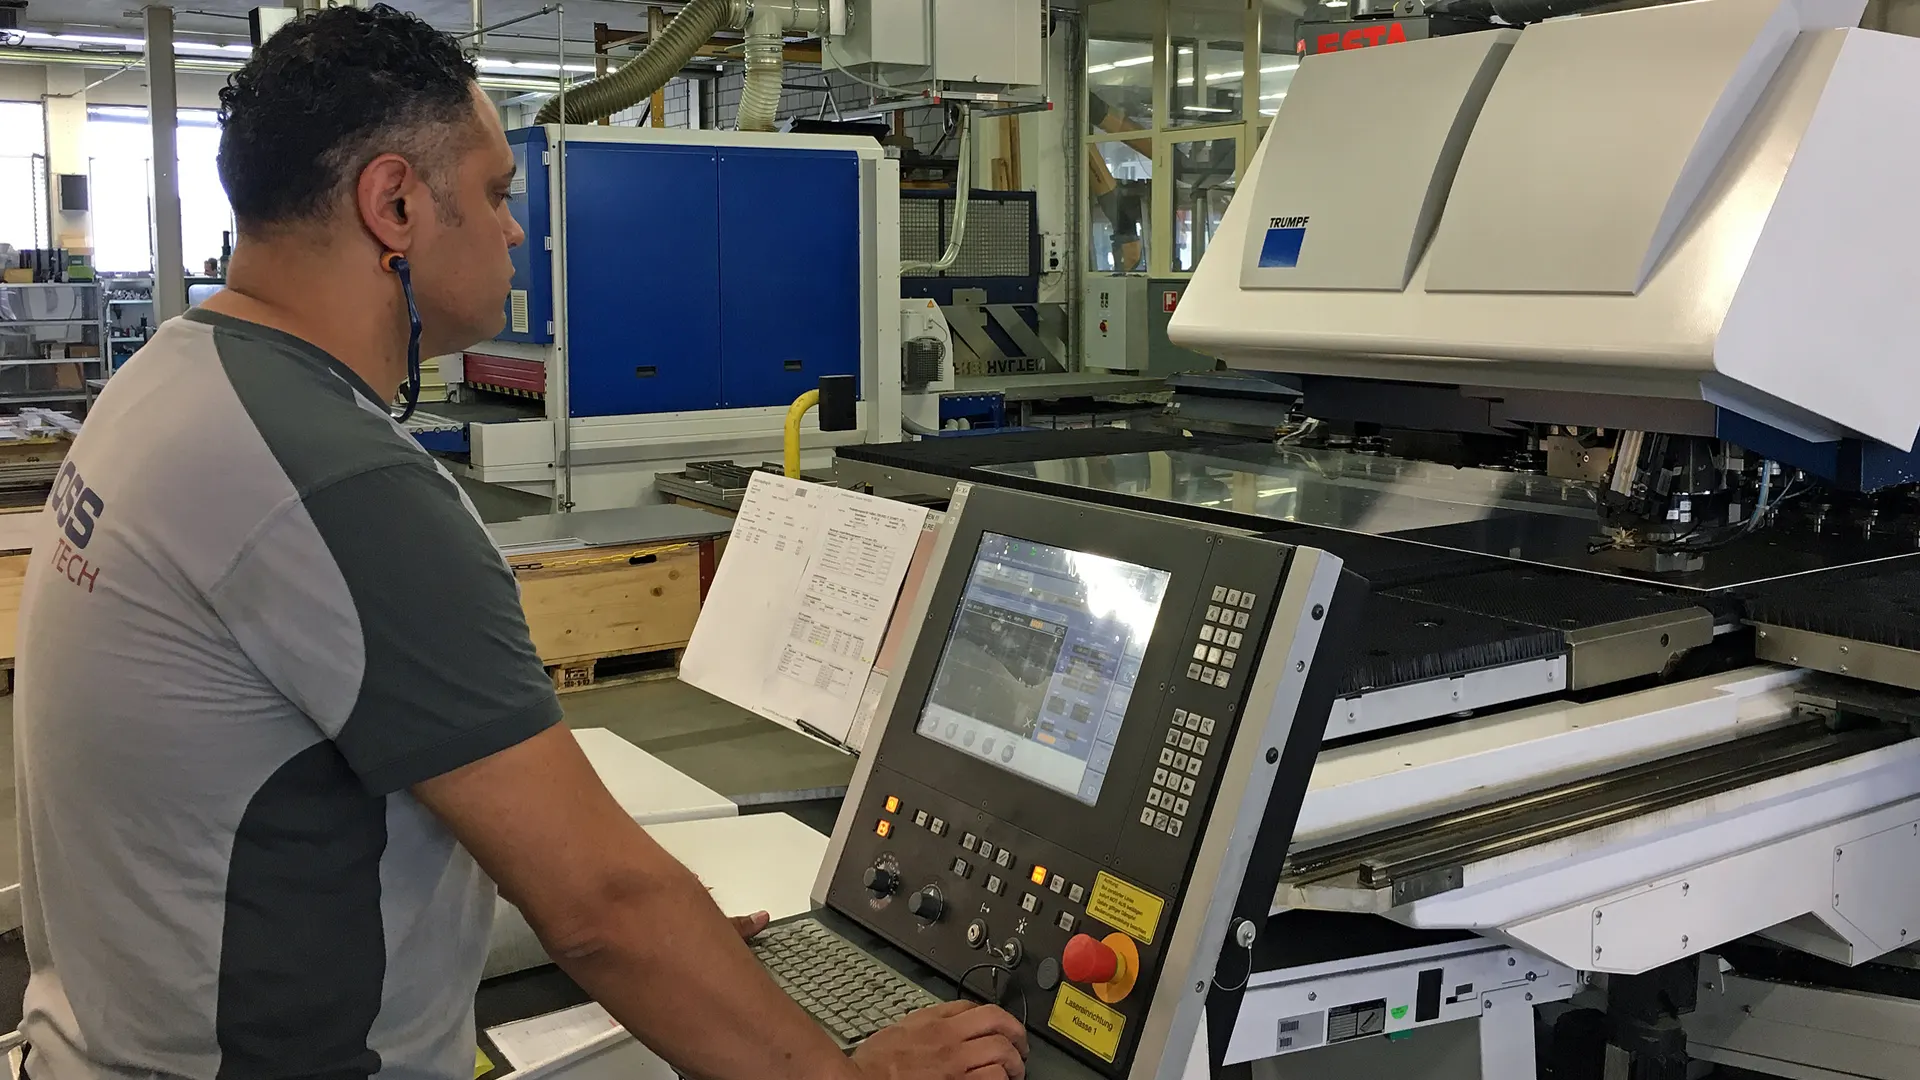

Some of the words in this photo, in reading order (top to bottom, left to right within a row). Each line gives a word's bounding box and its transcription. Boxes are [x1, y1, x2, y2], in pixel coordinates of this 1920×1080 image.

[1317, 22, 1407, 54] ESTA
[1269, 216, 1310, 228] TRUMPF
[51, 459, 105, 550] OSS
[51, 537, 100, 593] TECH
[1064, 996, 1114, 1032] Lasereinrichtung
[1072, 1015, 1092, 1033] Klasse
[1093, 1027, 1098, 1036] 1
